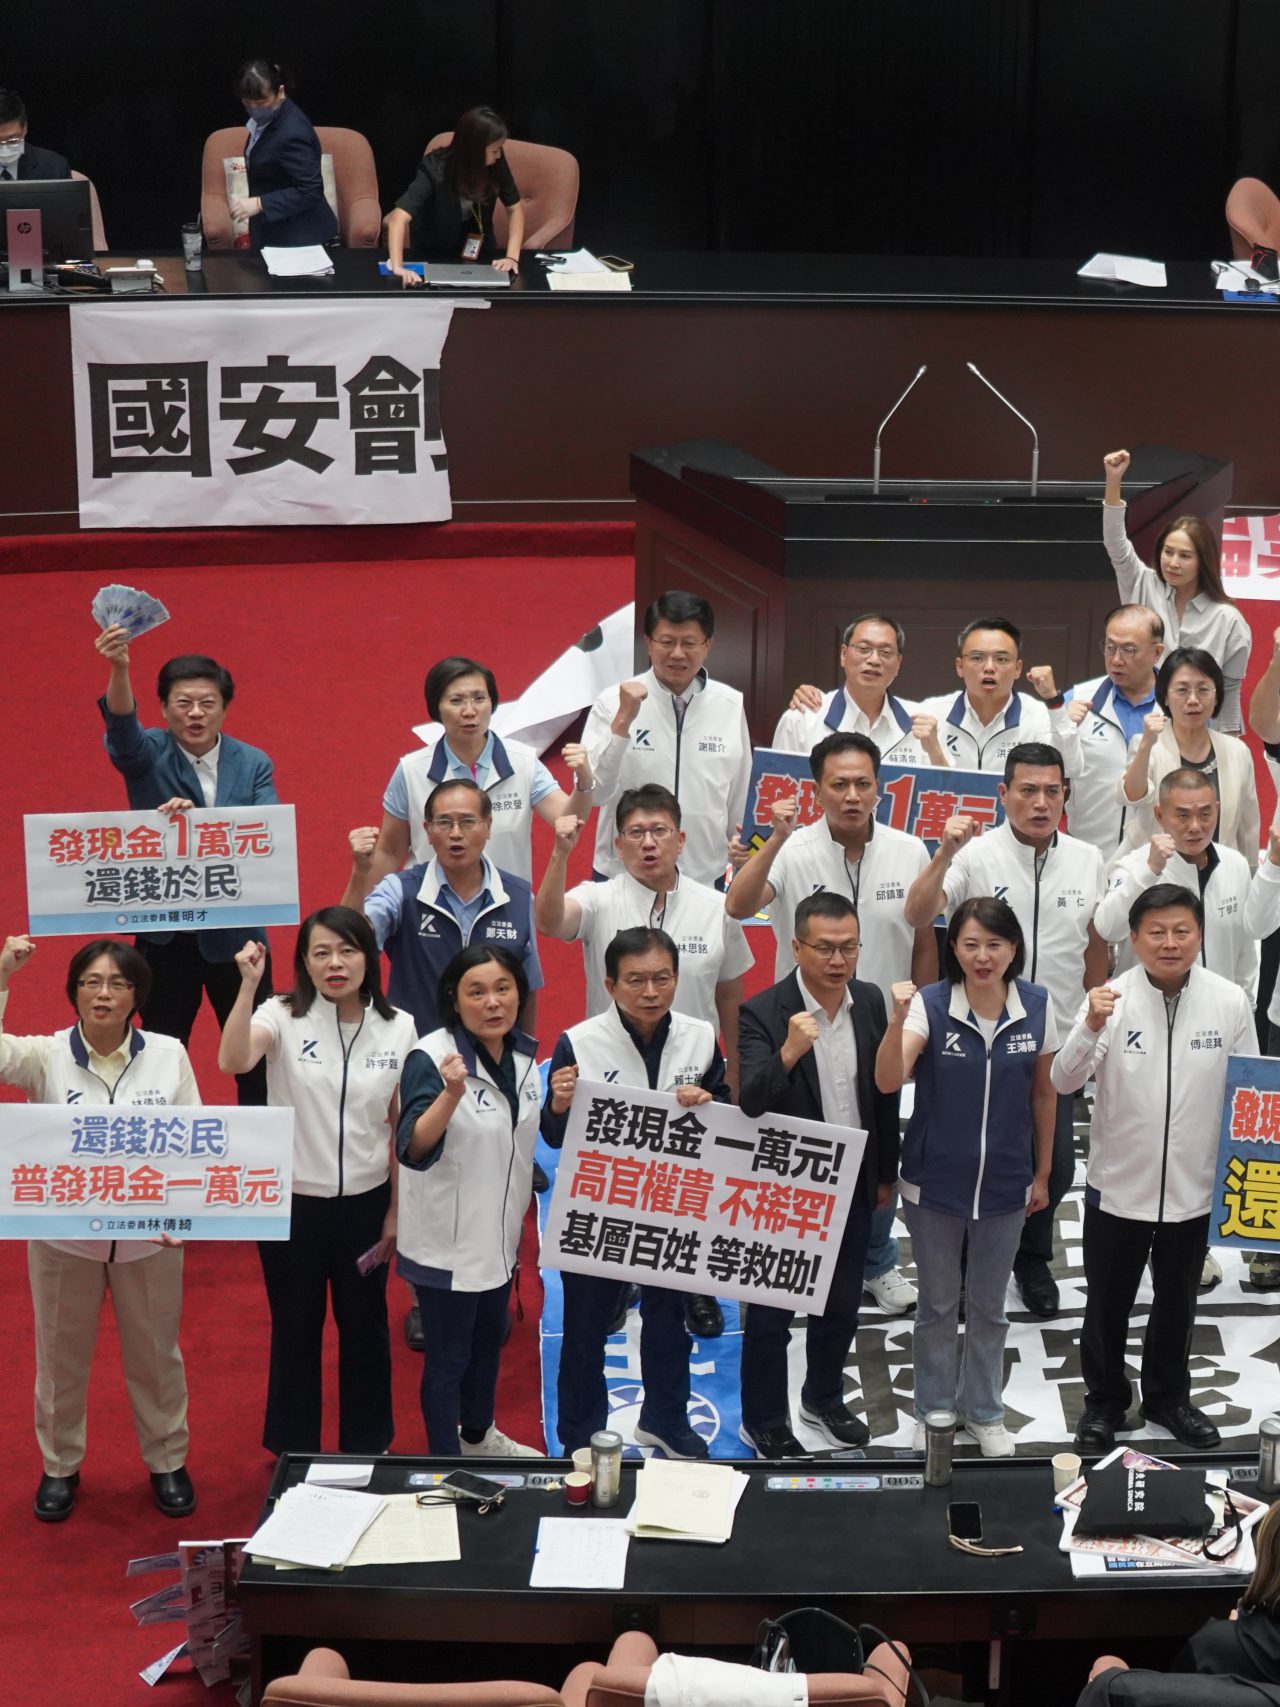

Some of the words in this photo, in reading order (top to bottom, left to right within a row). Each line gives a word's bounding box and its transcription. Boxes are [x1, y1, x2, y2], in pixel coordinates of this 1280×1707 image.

[87, 355, 448, 479] 國安會
[48, 814, 272, 865] 發現金1萬元
[84, 863, 240, 905] 還錢於民
[71, 1116, 226, 1156] 還錢於民
[585, 1097, 708, 1160] 發現金
[714, 1126, 846, 1186] 一萬元!
[11, 1164, 281, 1205] 普發現金一萬元
[569, 1150, 714, 1222] 高官權貴
[719, 1175, 837, 1242] 不稀罕!
[559, 1209, 702, 1275] 基層百姓
[706, 1233, 823, 1297] 等救助!
[887, 1477, 920, 1487] 005
[1234, 1467, 1258, 1478] 00
